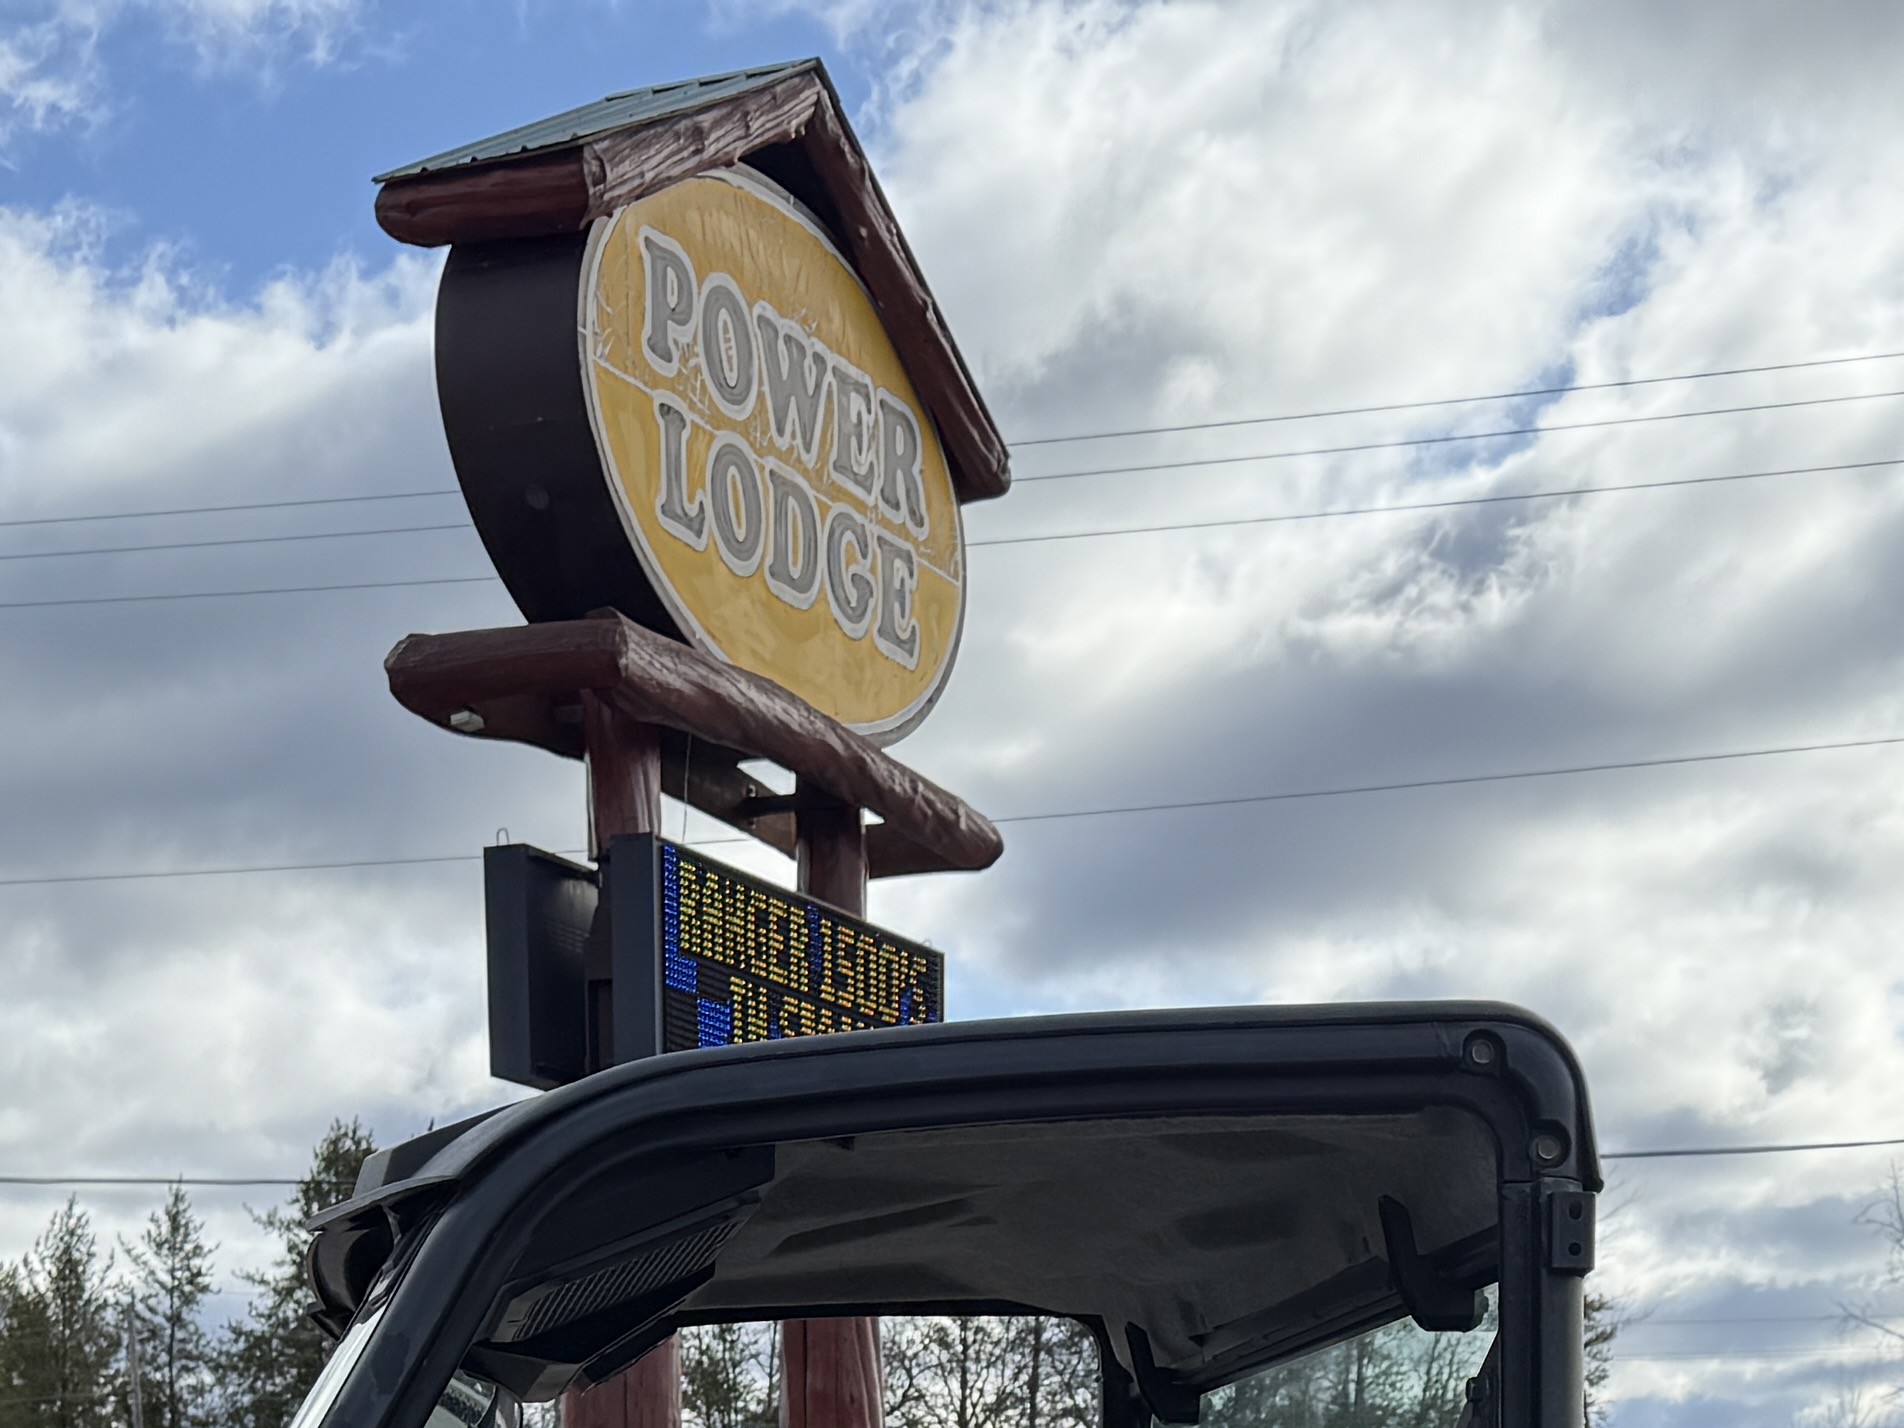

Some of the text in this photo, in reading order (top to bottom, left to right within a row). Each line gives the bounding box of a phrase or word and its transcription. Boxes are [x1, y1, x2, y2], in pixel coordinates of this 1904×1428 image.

[640, 226, 928, 540] POWER
[652, 390, 920, 670] LODGE
[680, 861, 808, 992] RANGER
